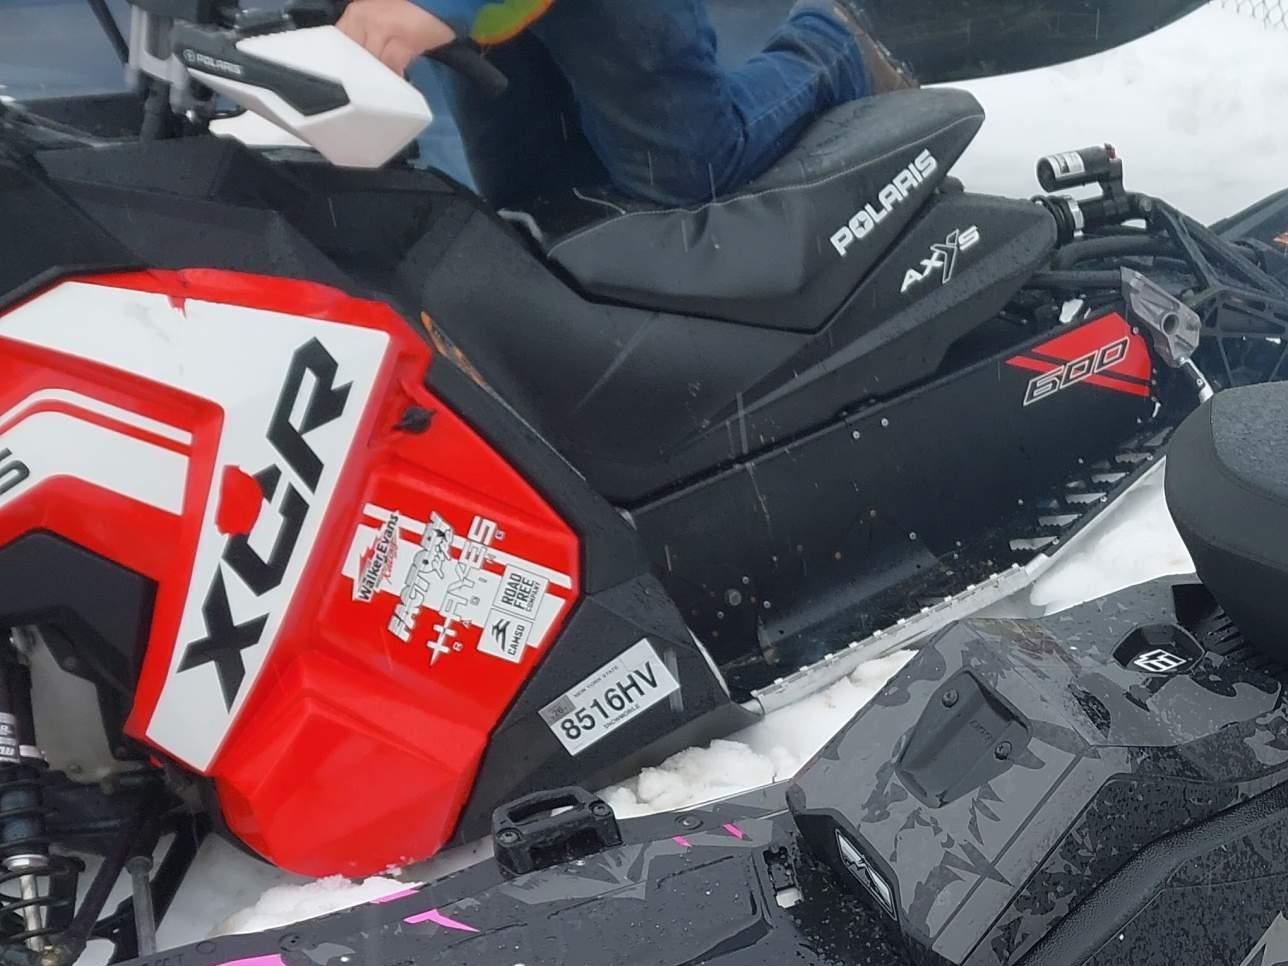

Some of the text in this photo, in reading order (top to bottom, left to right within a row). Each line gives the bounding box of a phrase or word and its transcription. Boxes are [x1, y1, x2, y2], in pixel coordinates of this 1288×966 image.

[830, 148, 938, 257] POLARIS
[900, 225, 980, 293] AXYS
[1023, 336, 1130, 406] 600
[176, 336, 353, 715] XCR
[376, 513, 399, 554] Evans
[387, 510, 453, 643] FACTORY
[501, 572, 522, 606] ROAD
[513, 577, 535, 610] FREE
[507, 624, 526, 656] CAMSO
[560, 660, 658, 740] 8516HV
